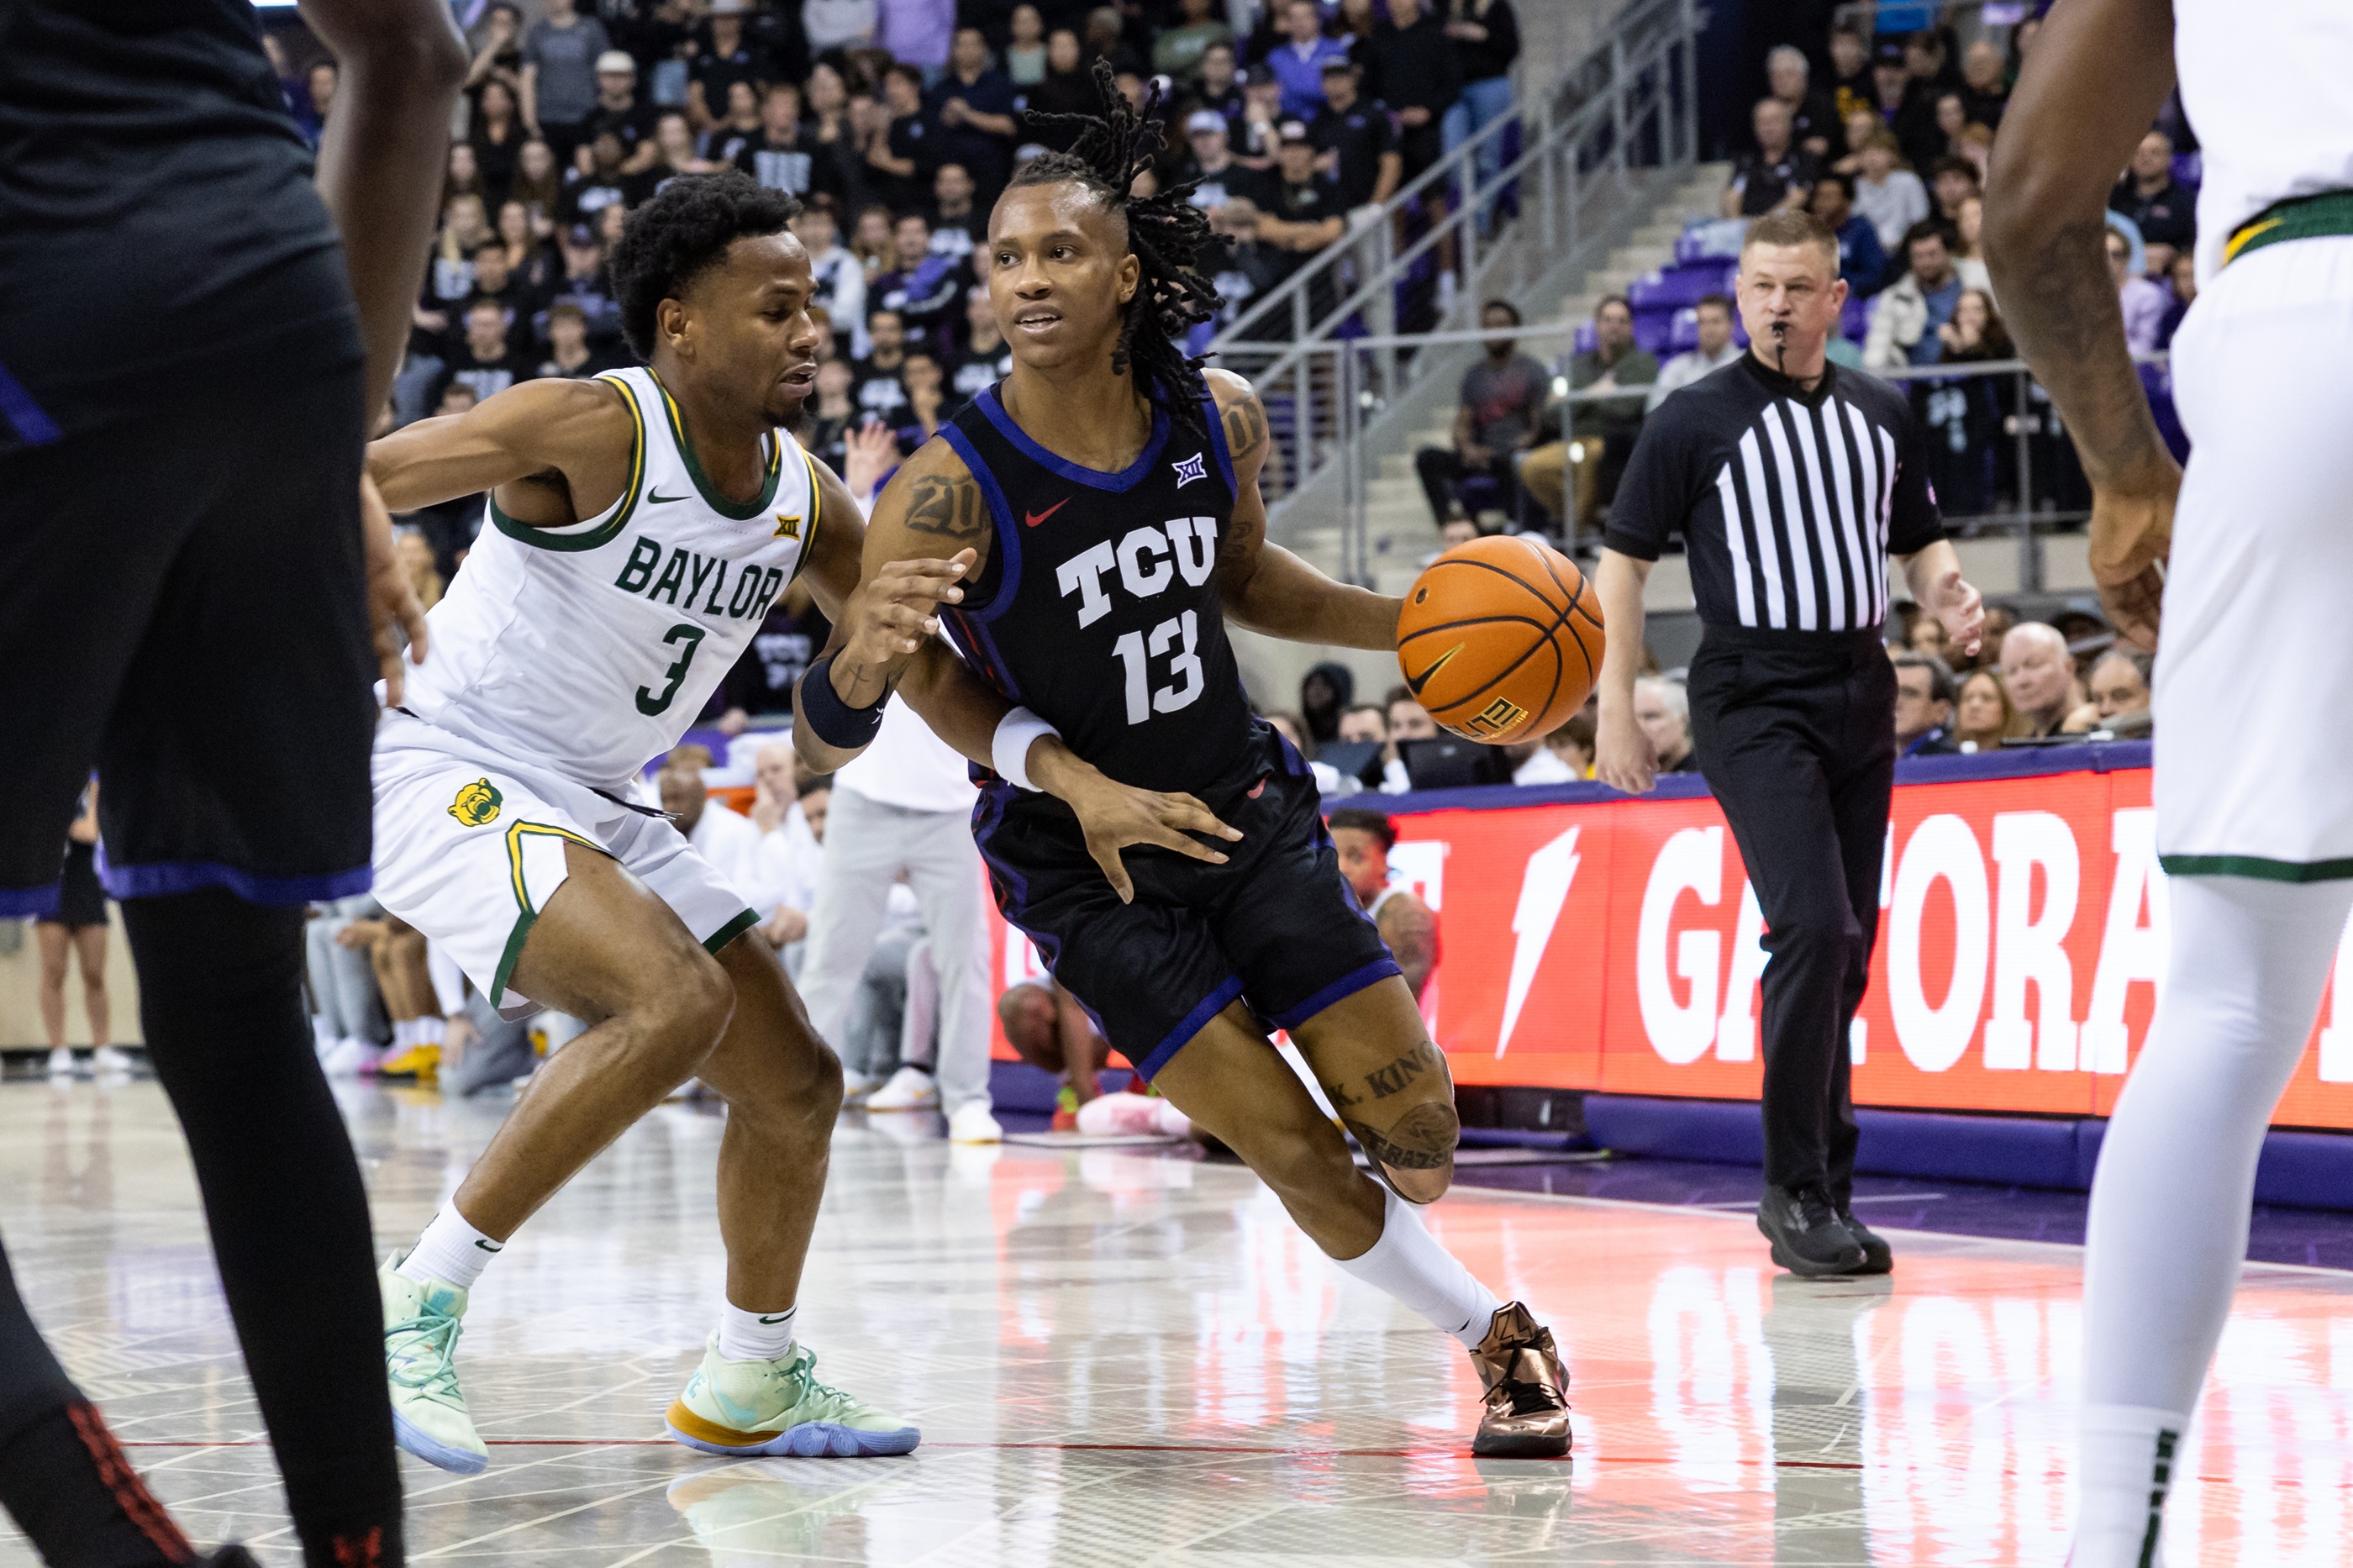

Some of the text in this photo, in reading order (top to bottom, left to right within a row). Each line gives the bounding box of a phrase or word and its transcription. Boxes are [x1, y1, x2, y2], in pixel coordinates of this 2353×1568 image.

[613, 534, 784, 622] BAYLOR
[1055, 516, 1219, 629] TCU
[635, 624, 706, 717] 3
[1111, 608, 1205, 725] 13
